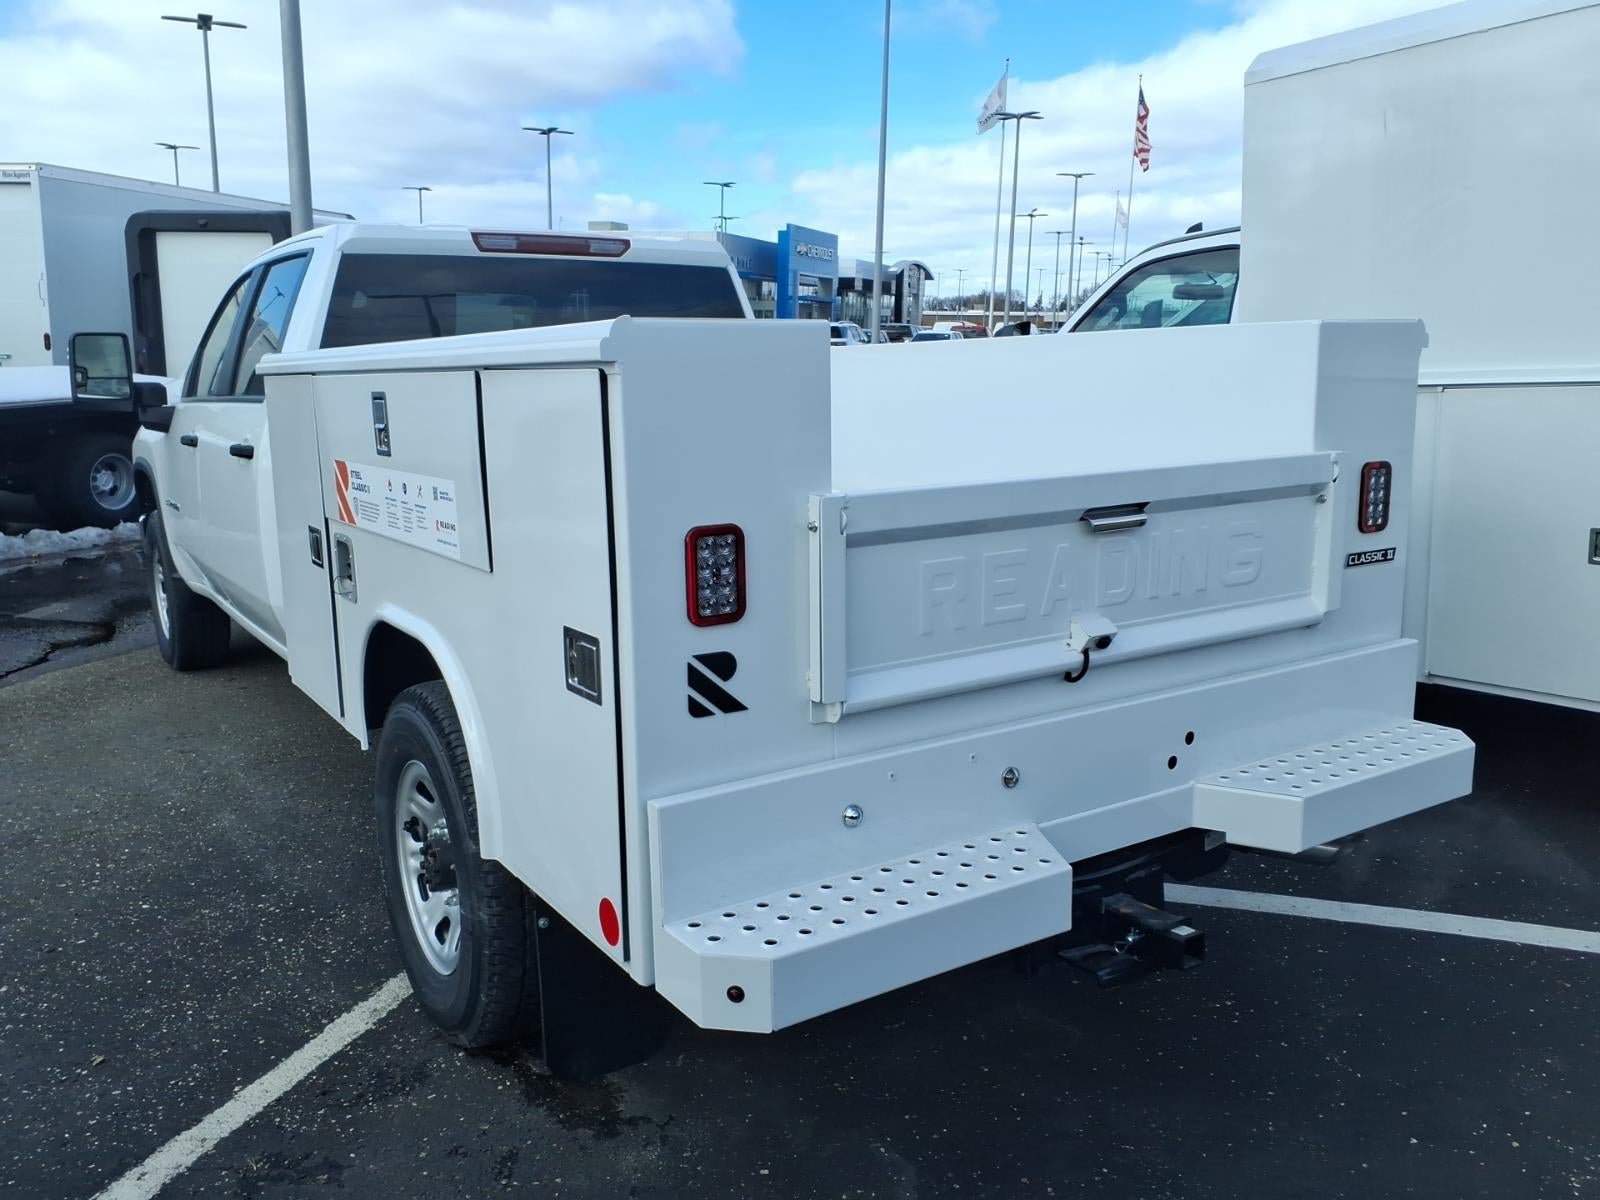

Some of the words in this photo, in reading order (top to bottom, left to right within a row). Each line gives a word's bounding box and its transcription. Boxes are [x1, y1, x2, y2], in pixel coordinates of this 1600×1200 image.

[807, 244, 833, 261] CHEVROLET
[1349, 550, 1385, 565] CLASSIC
[919, 519, 1264, 637] READING
